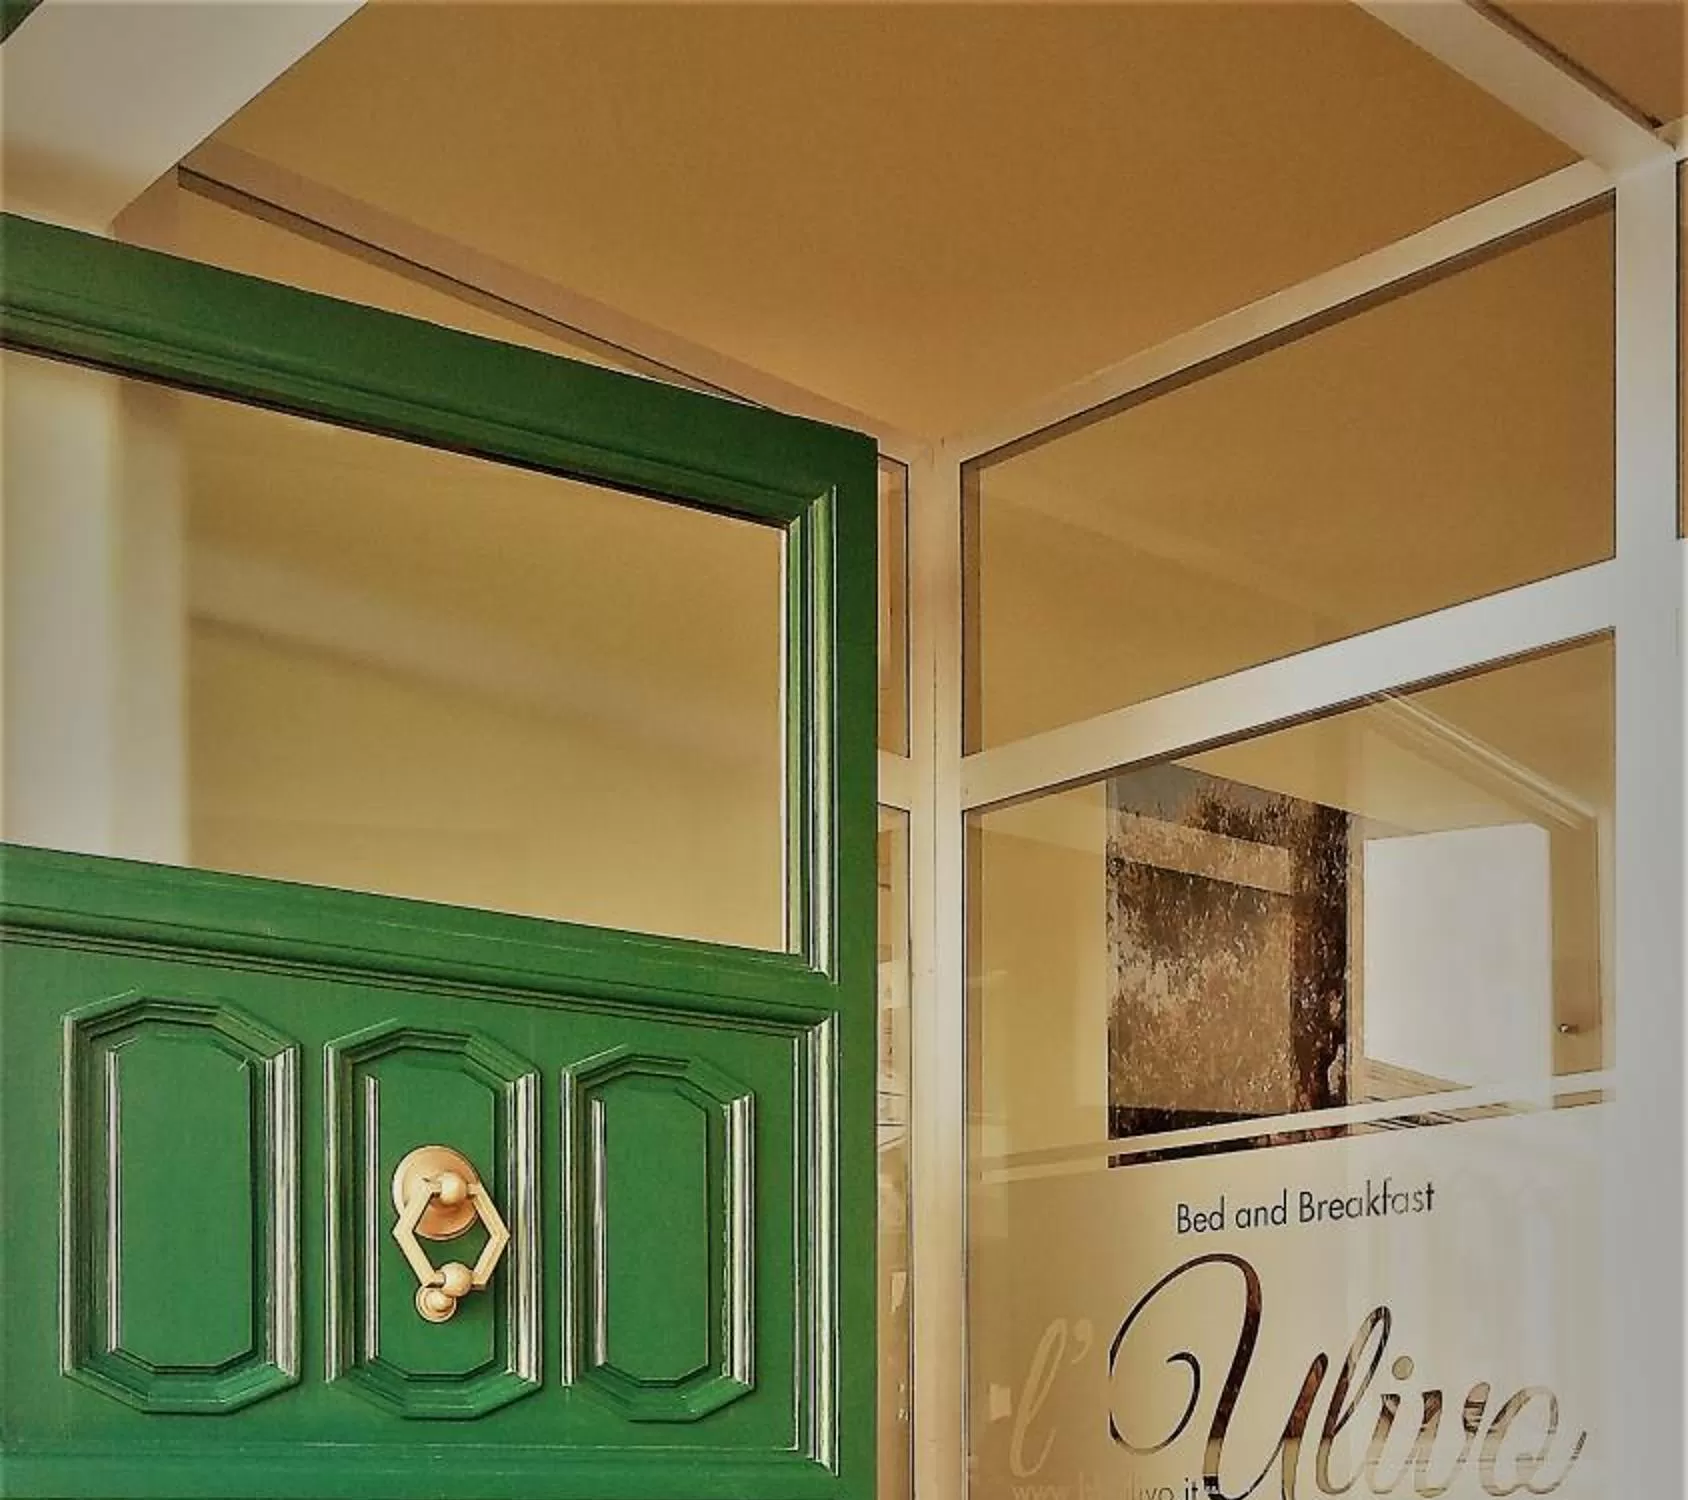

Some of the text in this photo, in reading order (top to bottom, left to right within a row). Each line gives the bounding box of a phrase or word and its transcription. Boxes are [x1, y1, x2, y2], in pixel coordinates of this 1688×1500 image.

[1176, 1177, 1434, 1234] Bed and Breakfast
